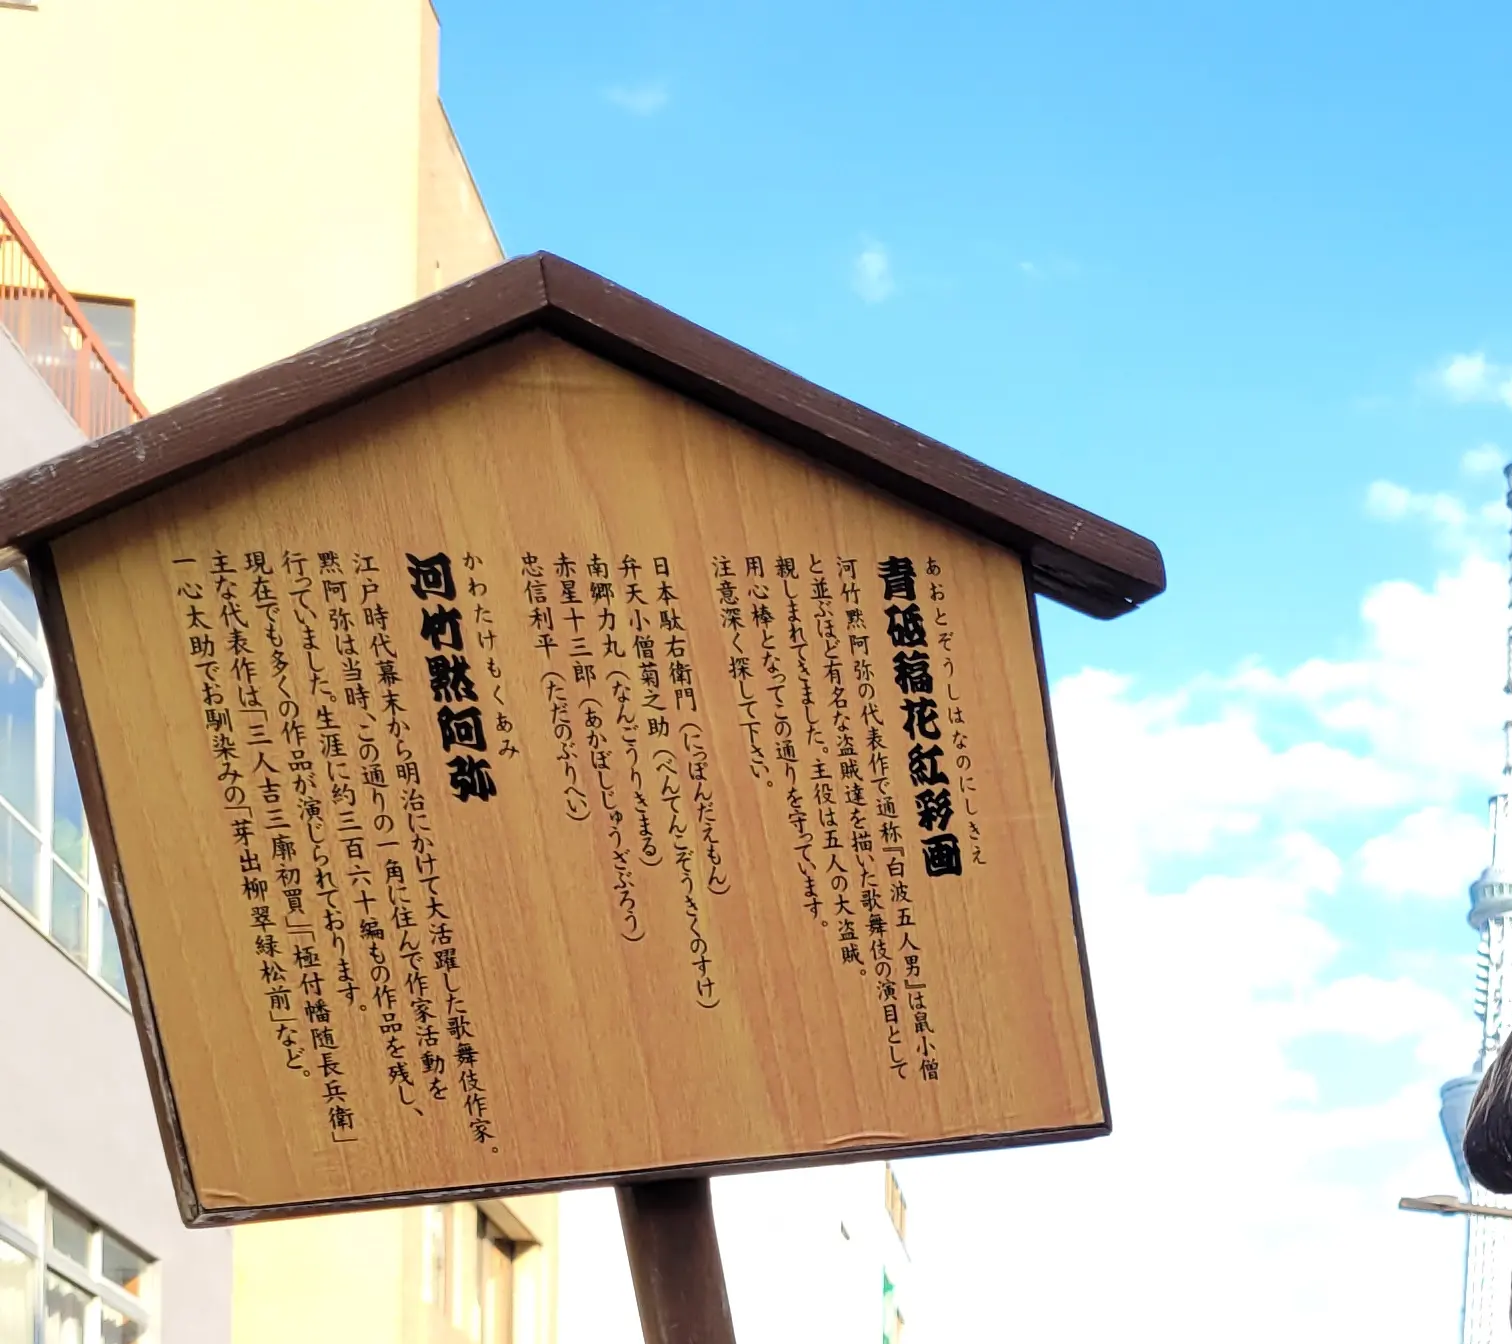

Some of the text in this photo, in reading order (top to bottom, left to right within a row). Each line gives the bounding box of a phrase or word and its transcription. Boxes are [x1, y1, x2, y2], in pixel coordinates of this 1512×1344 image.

[405, 552, 497, 802] 河竹黙阿弥
[463, 552, 520, 760] かわたけもくあみ
[712, 555, 774, 788] 注意深く探して下さい。
[745, 555, 828, 928] 用心棒となってこの通りを守っています。
[877, 555, 963, 878] 青砥稿花紅彩画
[926, 555, 987, 866] あおとぞうしはなのにしきえ
